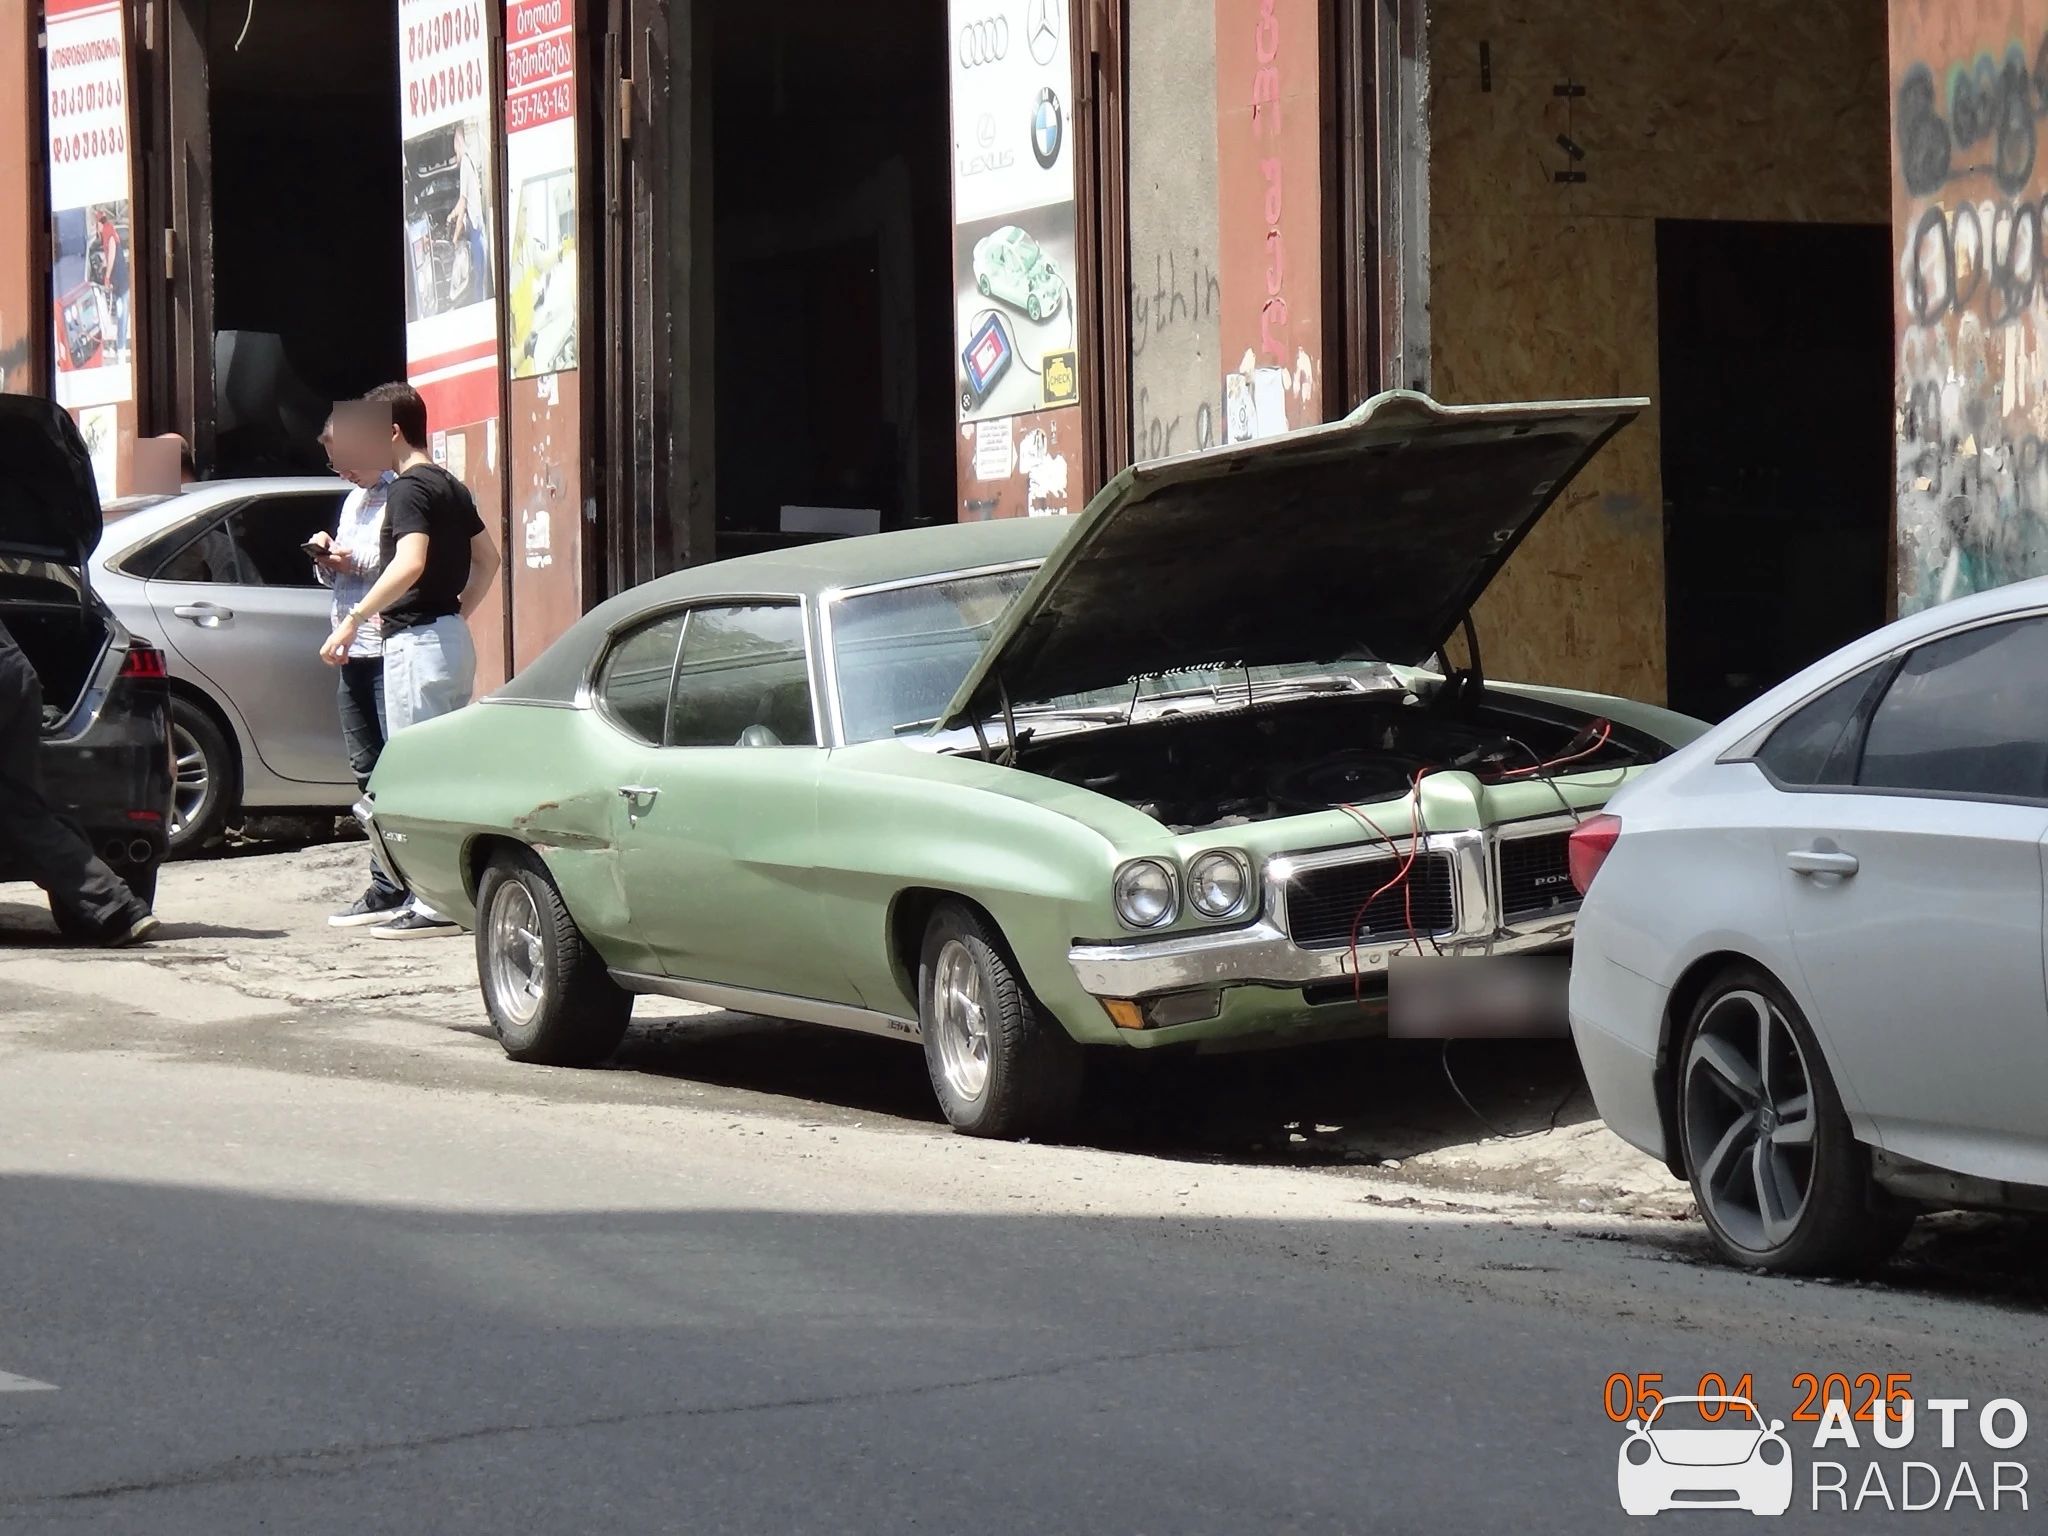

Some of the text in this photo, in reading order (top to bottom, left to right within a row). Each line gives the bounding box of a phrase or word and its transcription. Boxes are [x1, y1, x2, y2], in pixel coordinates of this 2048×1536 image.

[408, 2, 480, 63] შეკეთება
[509, 37, 571, 87] შემოწმება
[52, 79, 122, 119] შეკეთება
[409, 58, 482, 118] დატუმბვა
[511, 84, 569, 127] 557-743-143
[53, 126, 124, 164] დატუმბვა
[961, 150, 1015, 176] LEXUS
[1050, 371, 1071, 387] CHECK
[1534, 873, 1571, 886] PON
